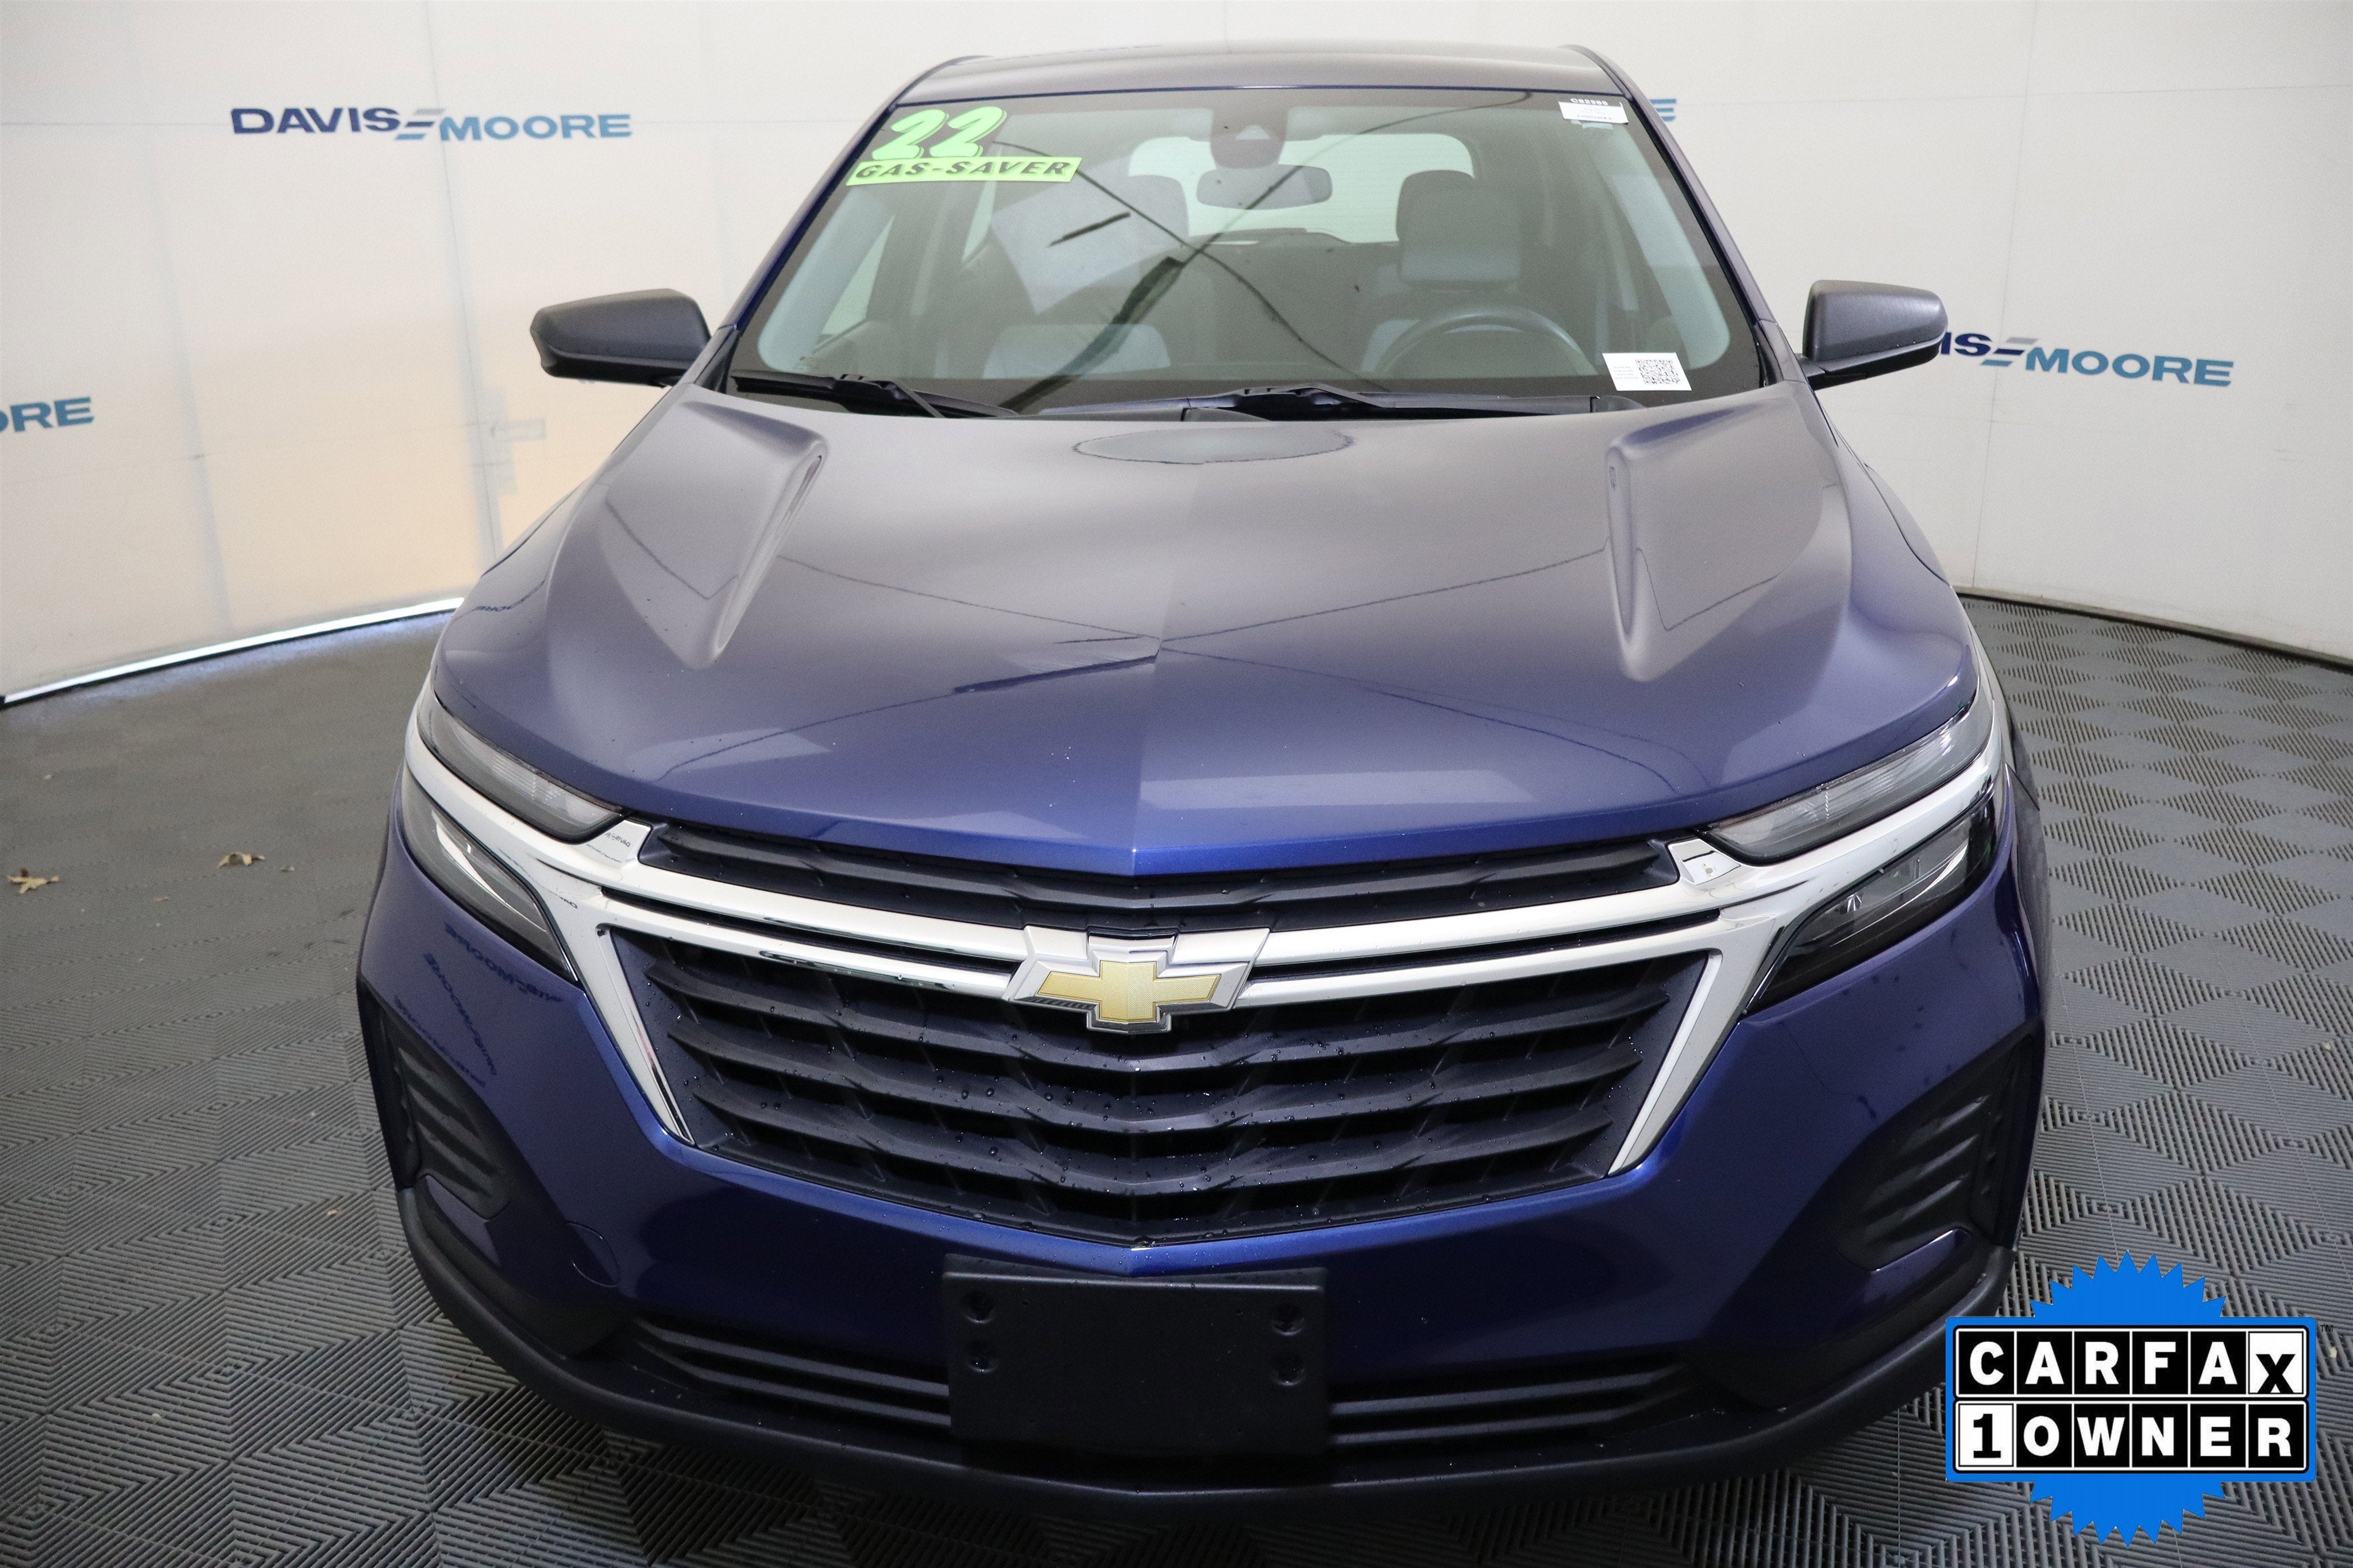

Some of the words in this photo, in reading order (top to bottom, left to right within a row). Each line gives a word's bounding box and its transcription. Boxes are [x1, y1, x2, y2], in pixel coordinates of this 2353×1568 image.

[231, 107, 401, 134] DAVIS
[439, 114, 632, 141] MOORE
[871, 106, 1008, 160] 22
[855, 161, 1072, 179] GAS-SAVER
[2026, 347, 2234, 387] MOORE
[0, 397, 94, 432] RE
